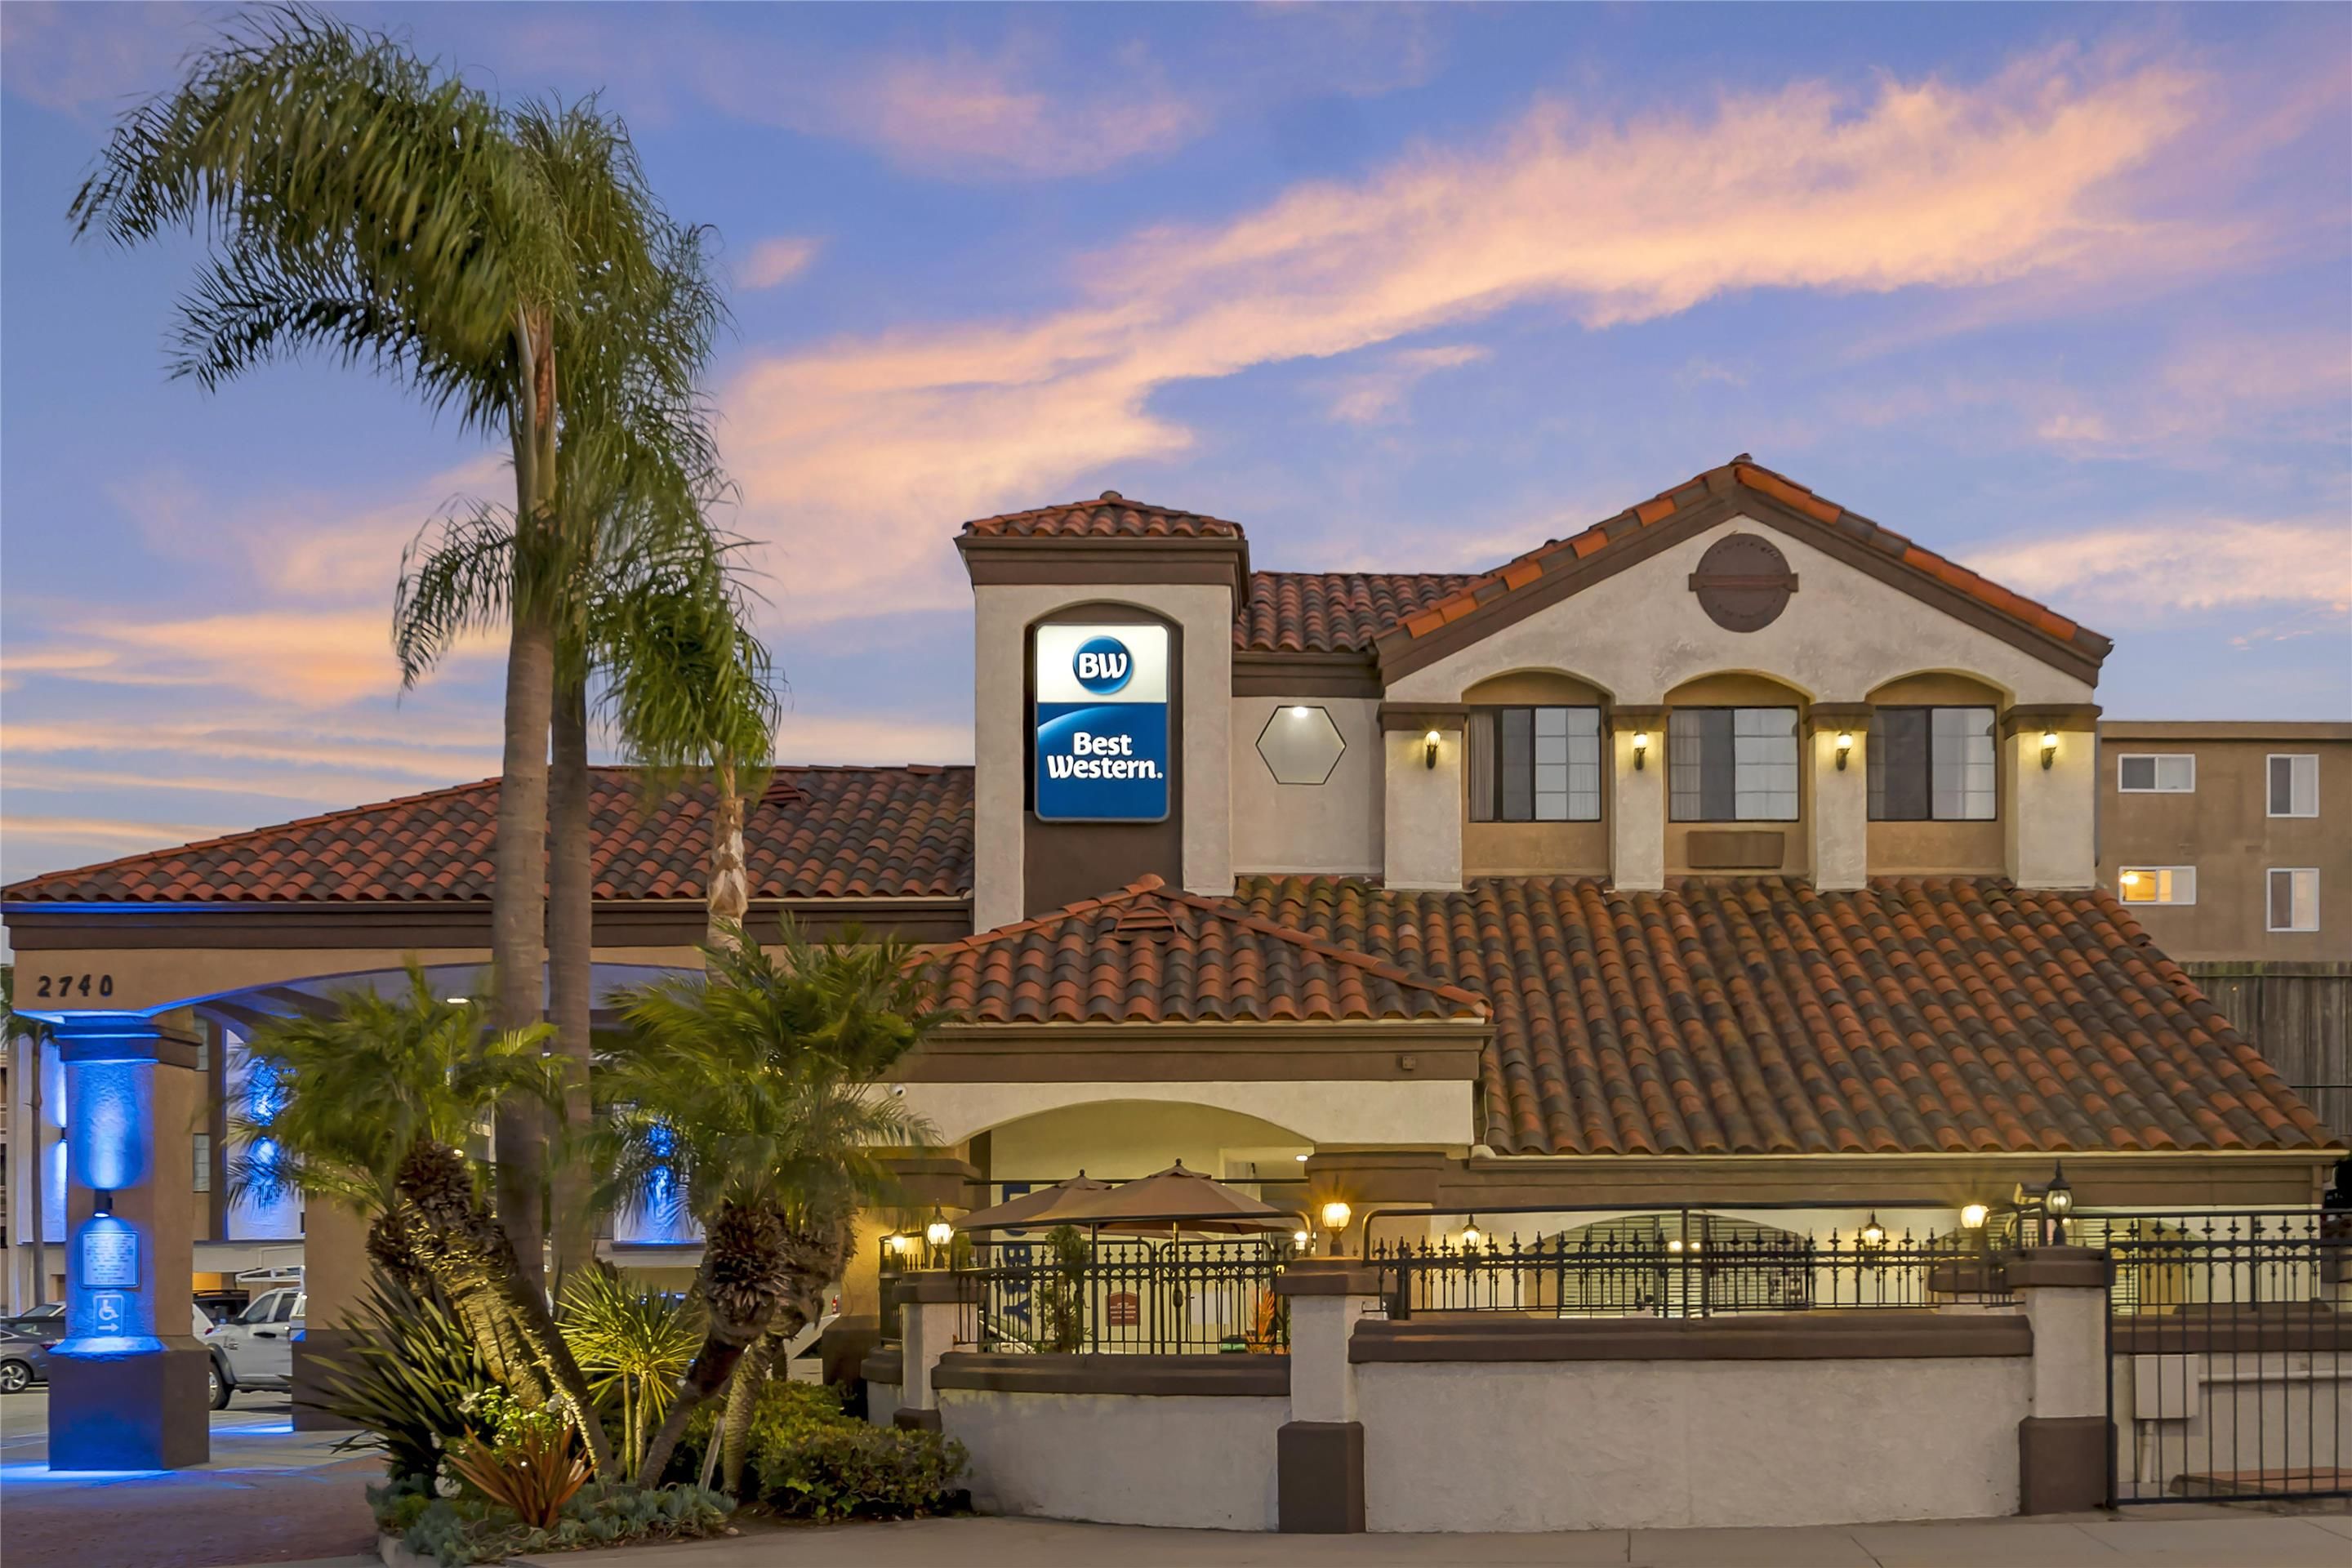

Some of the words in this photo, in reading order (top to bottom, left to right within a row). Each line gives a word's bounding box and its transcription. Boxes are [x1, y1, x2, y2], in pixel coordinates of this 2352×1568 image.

[1079, 653, 1127, 679] BW
[1073, 732, 1133, 755] Best
[37, 974, 113, 997] 2740
[1002, 1183, 1032, 1325] LBBY
